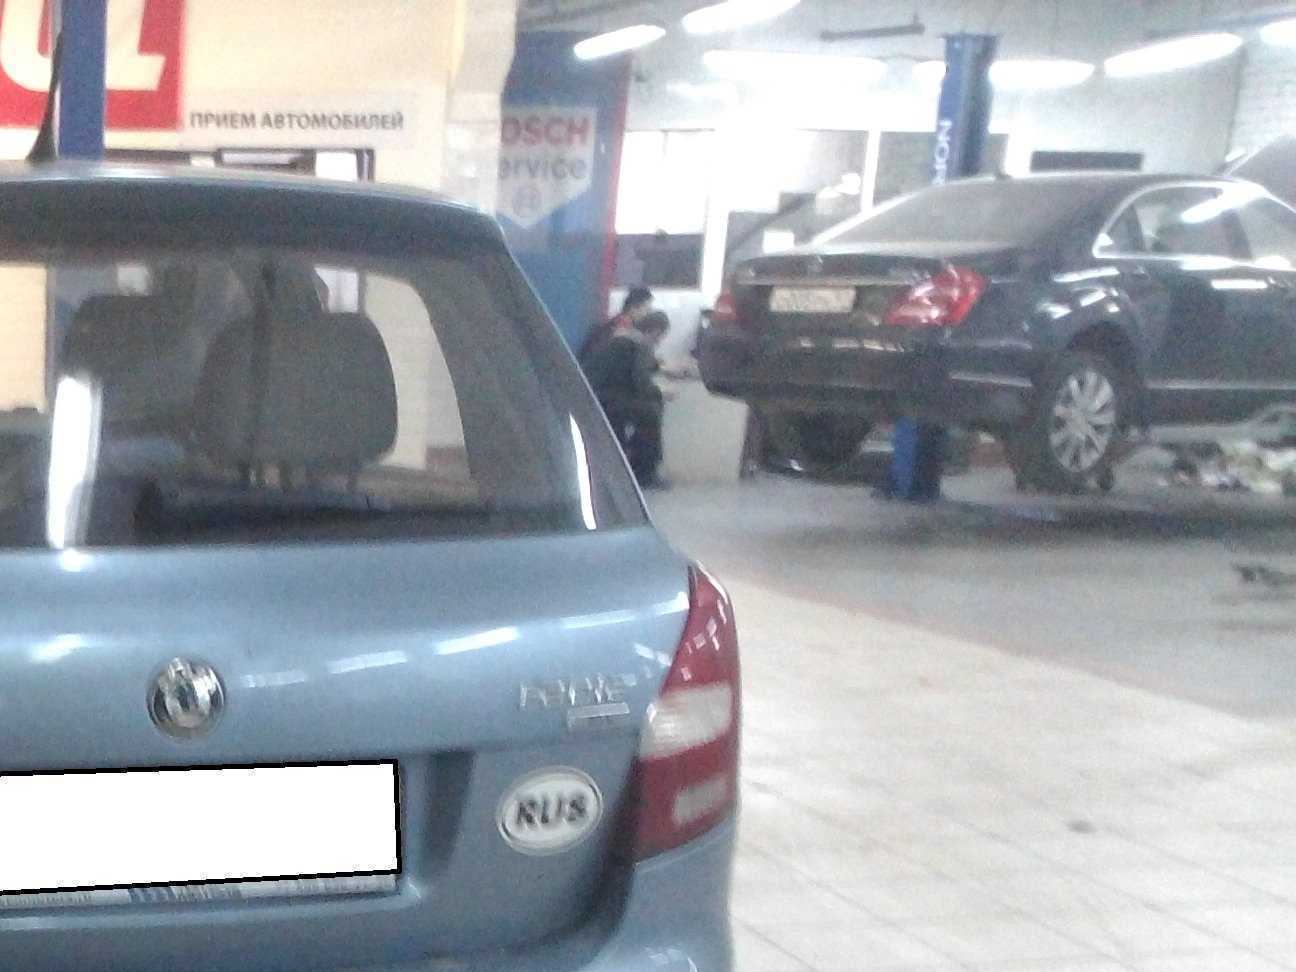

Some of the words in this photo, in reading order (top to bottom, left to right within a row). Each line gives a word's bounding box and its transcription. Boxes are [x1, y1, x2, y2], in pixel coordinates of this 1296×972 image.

[189, 112, 255, 129] ПРИЕМ
[260, 111, 404, 130] АВТОМОБИЛЕЙ
[515, 793, 587, 829] RUS
